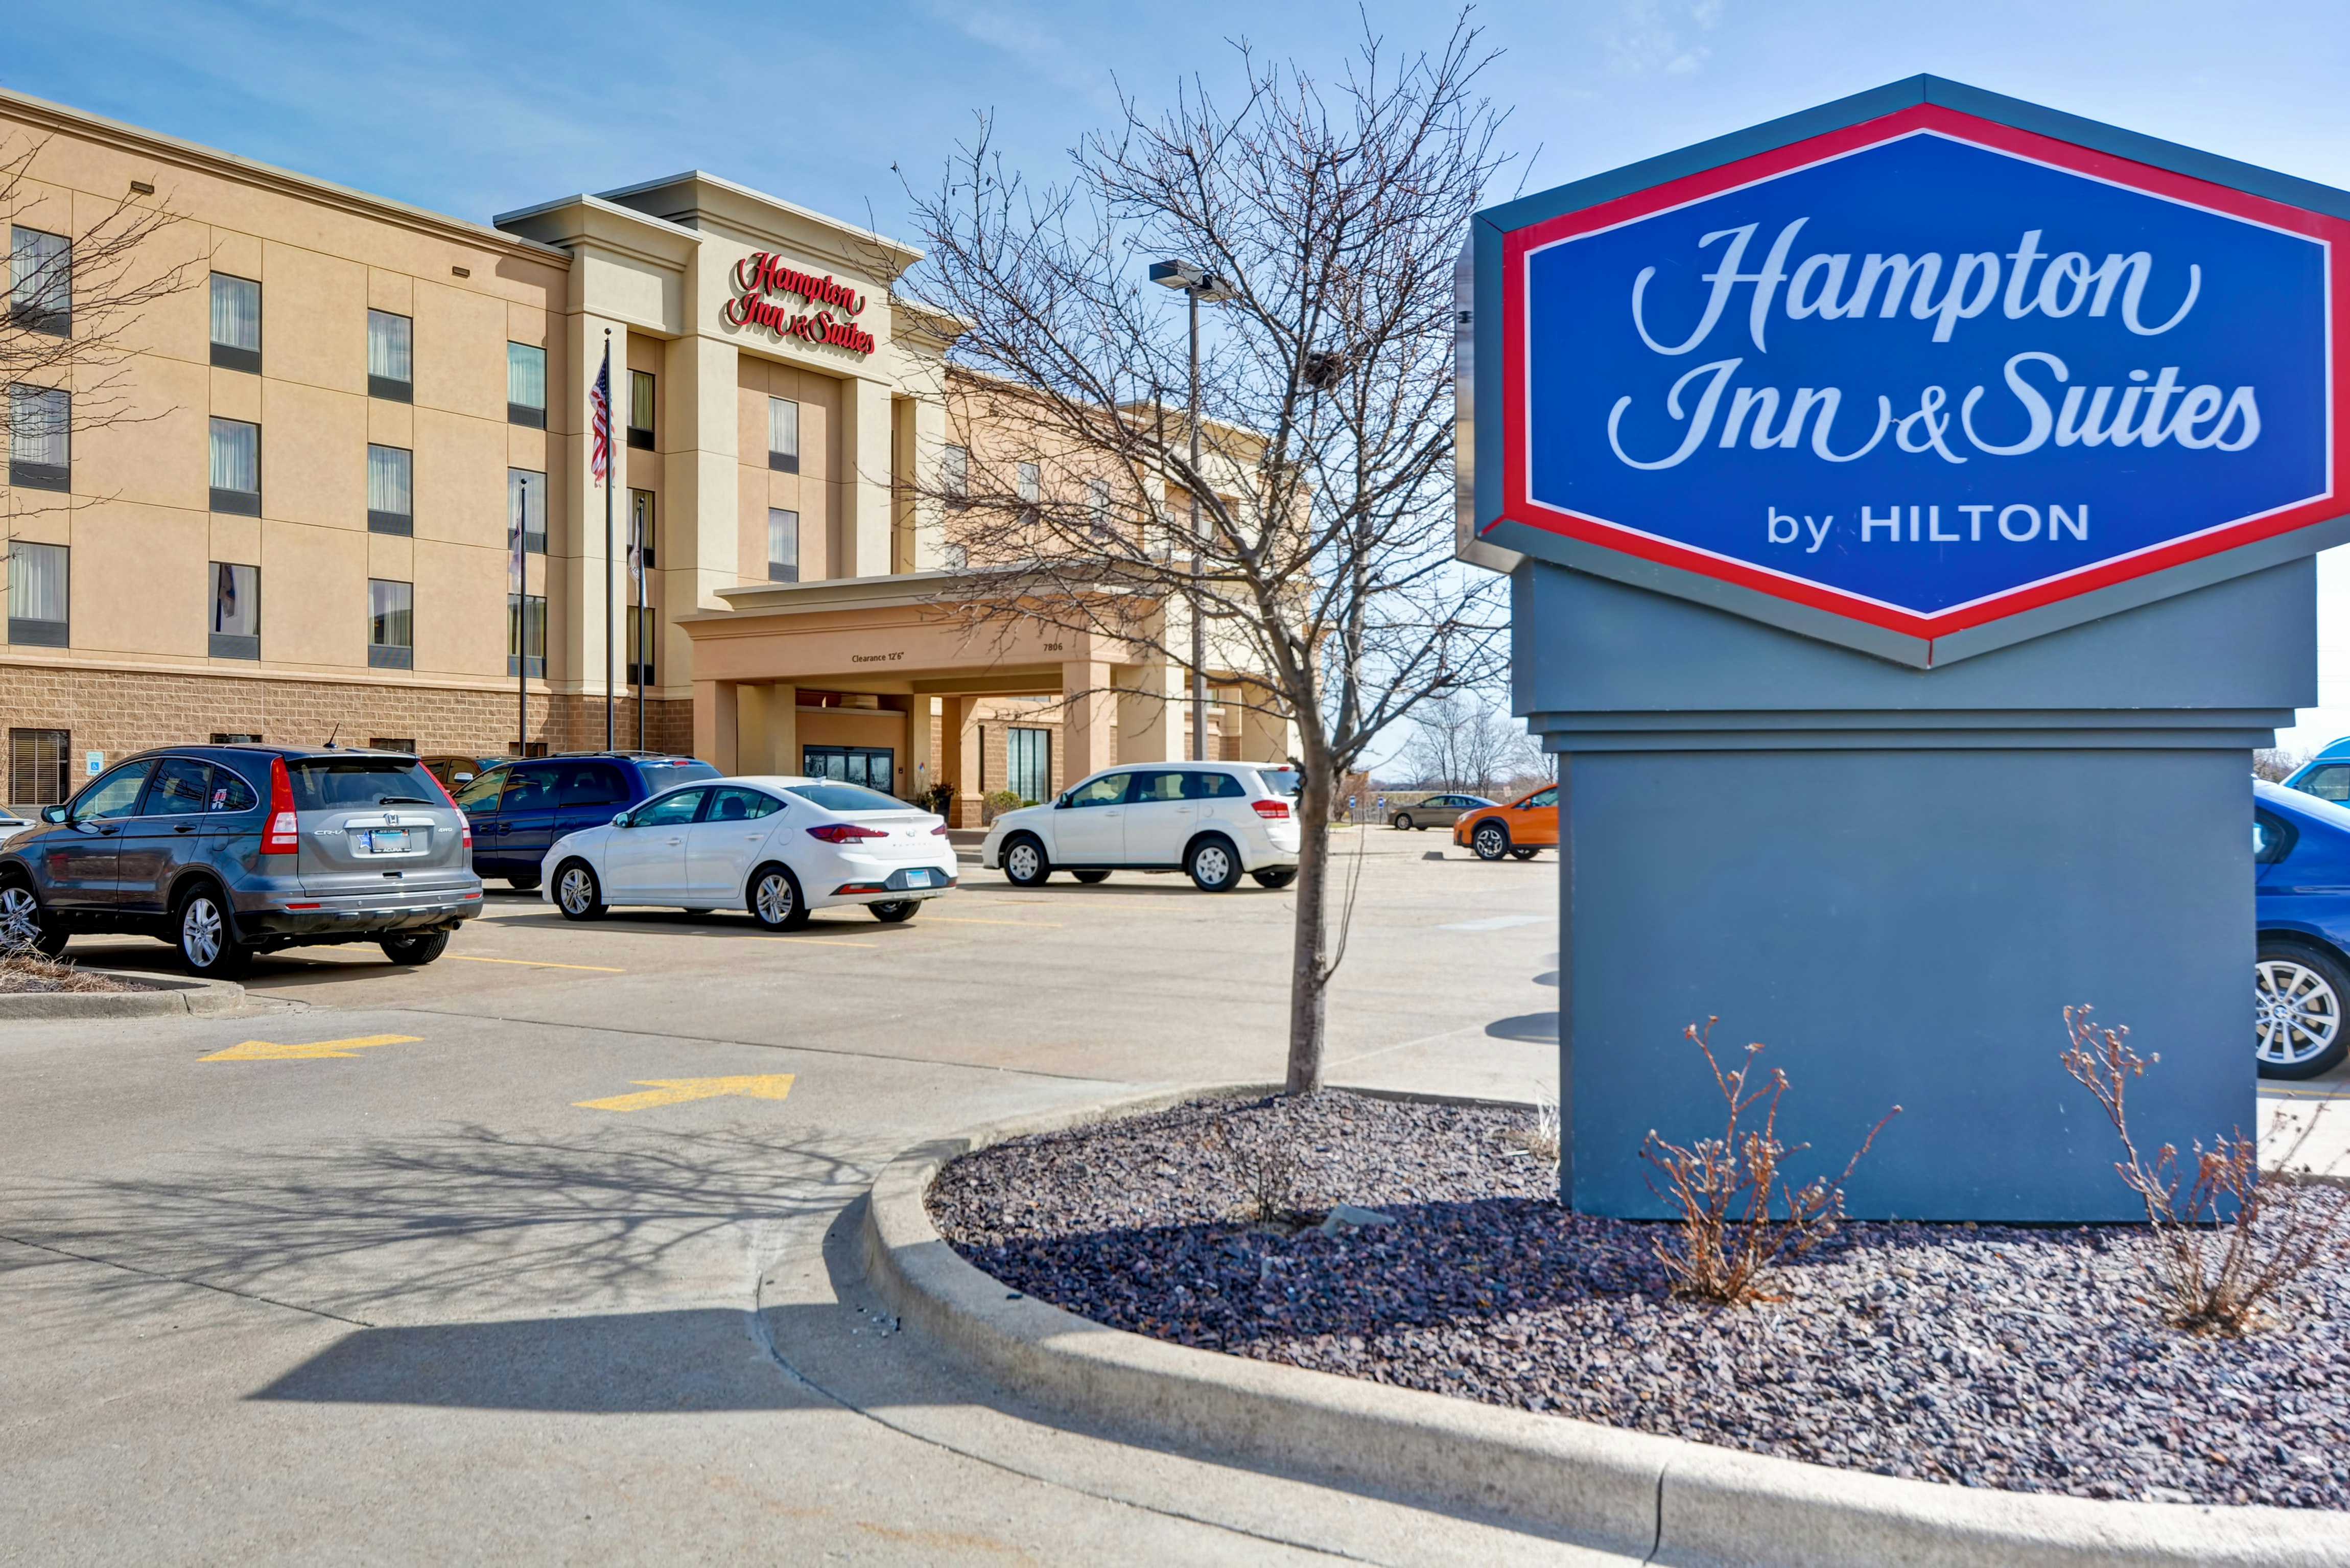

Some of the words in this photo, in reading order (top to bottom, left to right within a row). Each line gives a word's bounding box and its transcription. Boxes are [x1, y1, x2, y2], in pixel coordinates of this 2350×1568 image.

[737, 252, 865, 316] Hampton
[1632, 216, 2201, 356] Hampton
[726, 293, 796, 336] Inn
[795, 315, 812, 342] &
[808, 311, 875, 354] Suites
[1607, 357, 1891, 471] Inn
[1895, 385, 1968, 464] &
[1961, 351, 2261, 456] Suites
[1767, 506, 1834, 553] by
[1861, 504, 2089, 542] HILTON
[1043, 643, 1063, 651] 7806
